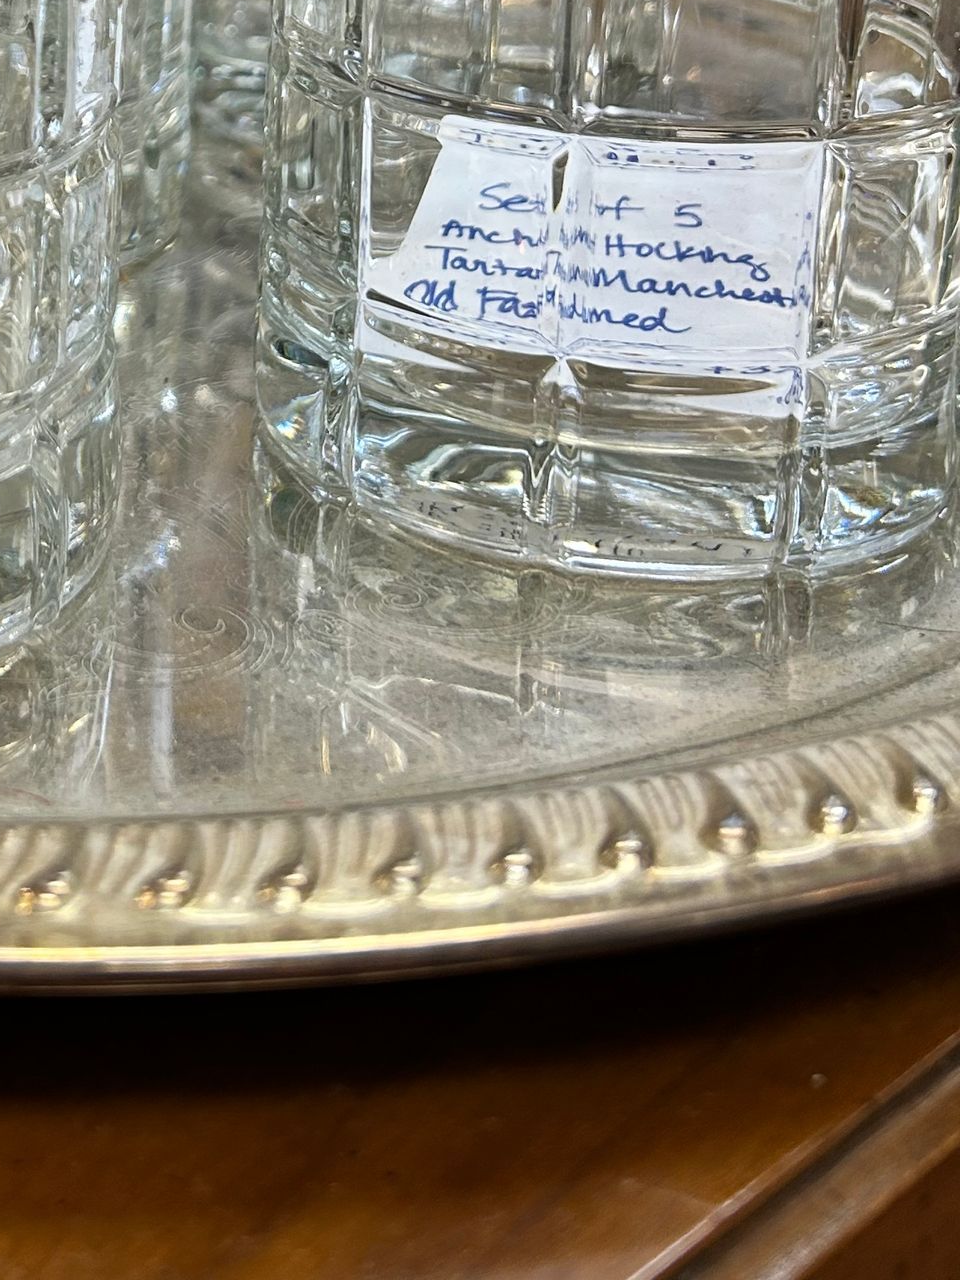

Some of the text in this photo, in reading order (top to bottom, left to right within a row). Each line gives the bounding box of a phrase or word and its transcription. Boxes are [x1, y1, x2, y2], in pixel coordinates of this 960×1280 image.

[674, 203, 703, 228] 5
[605, 233, 771, 282] Hocking
[404, 279, 459, 312] Old
